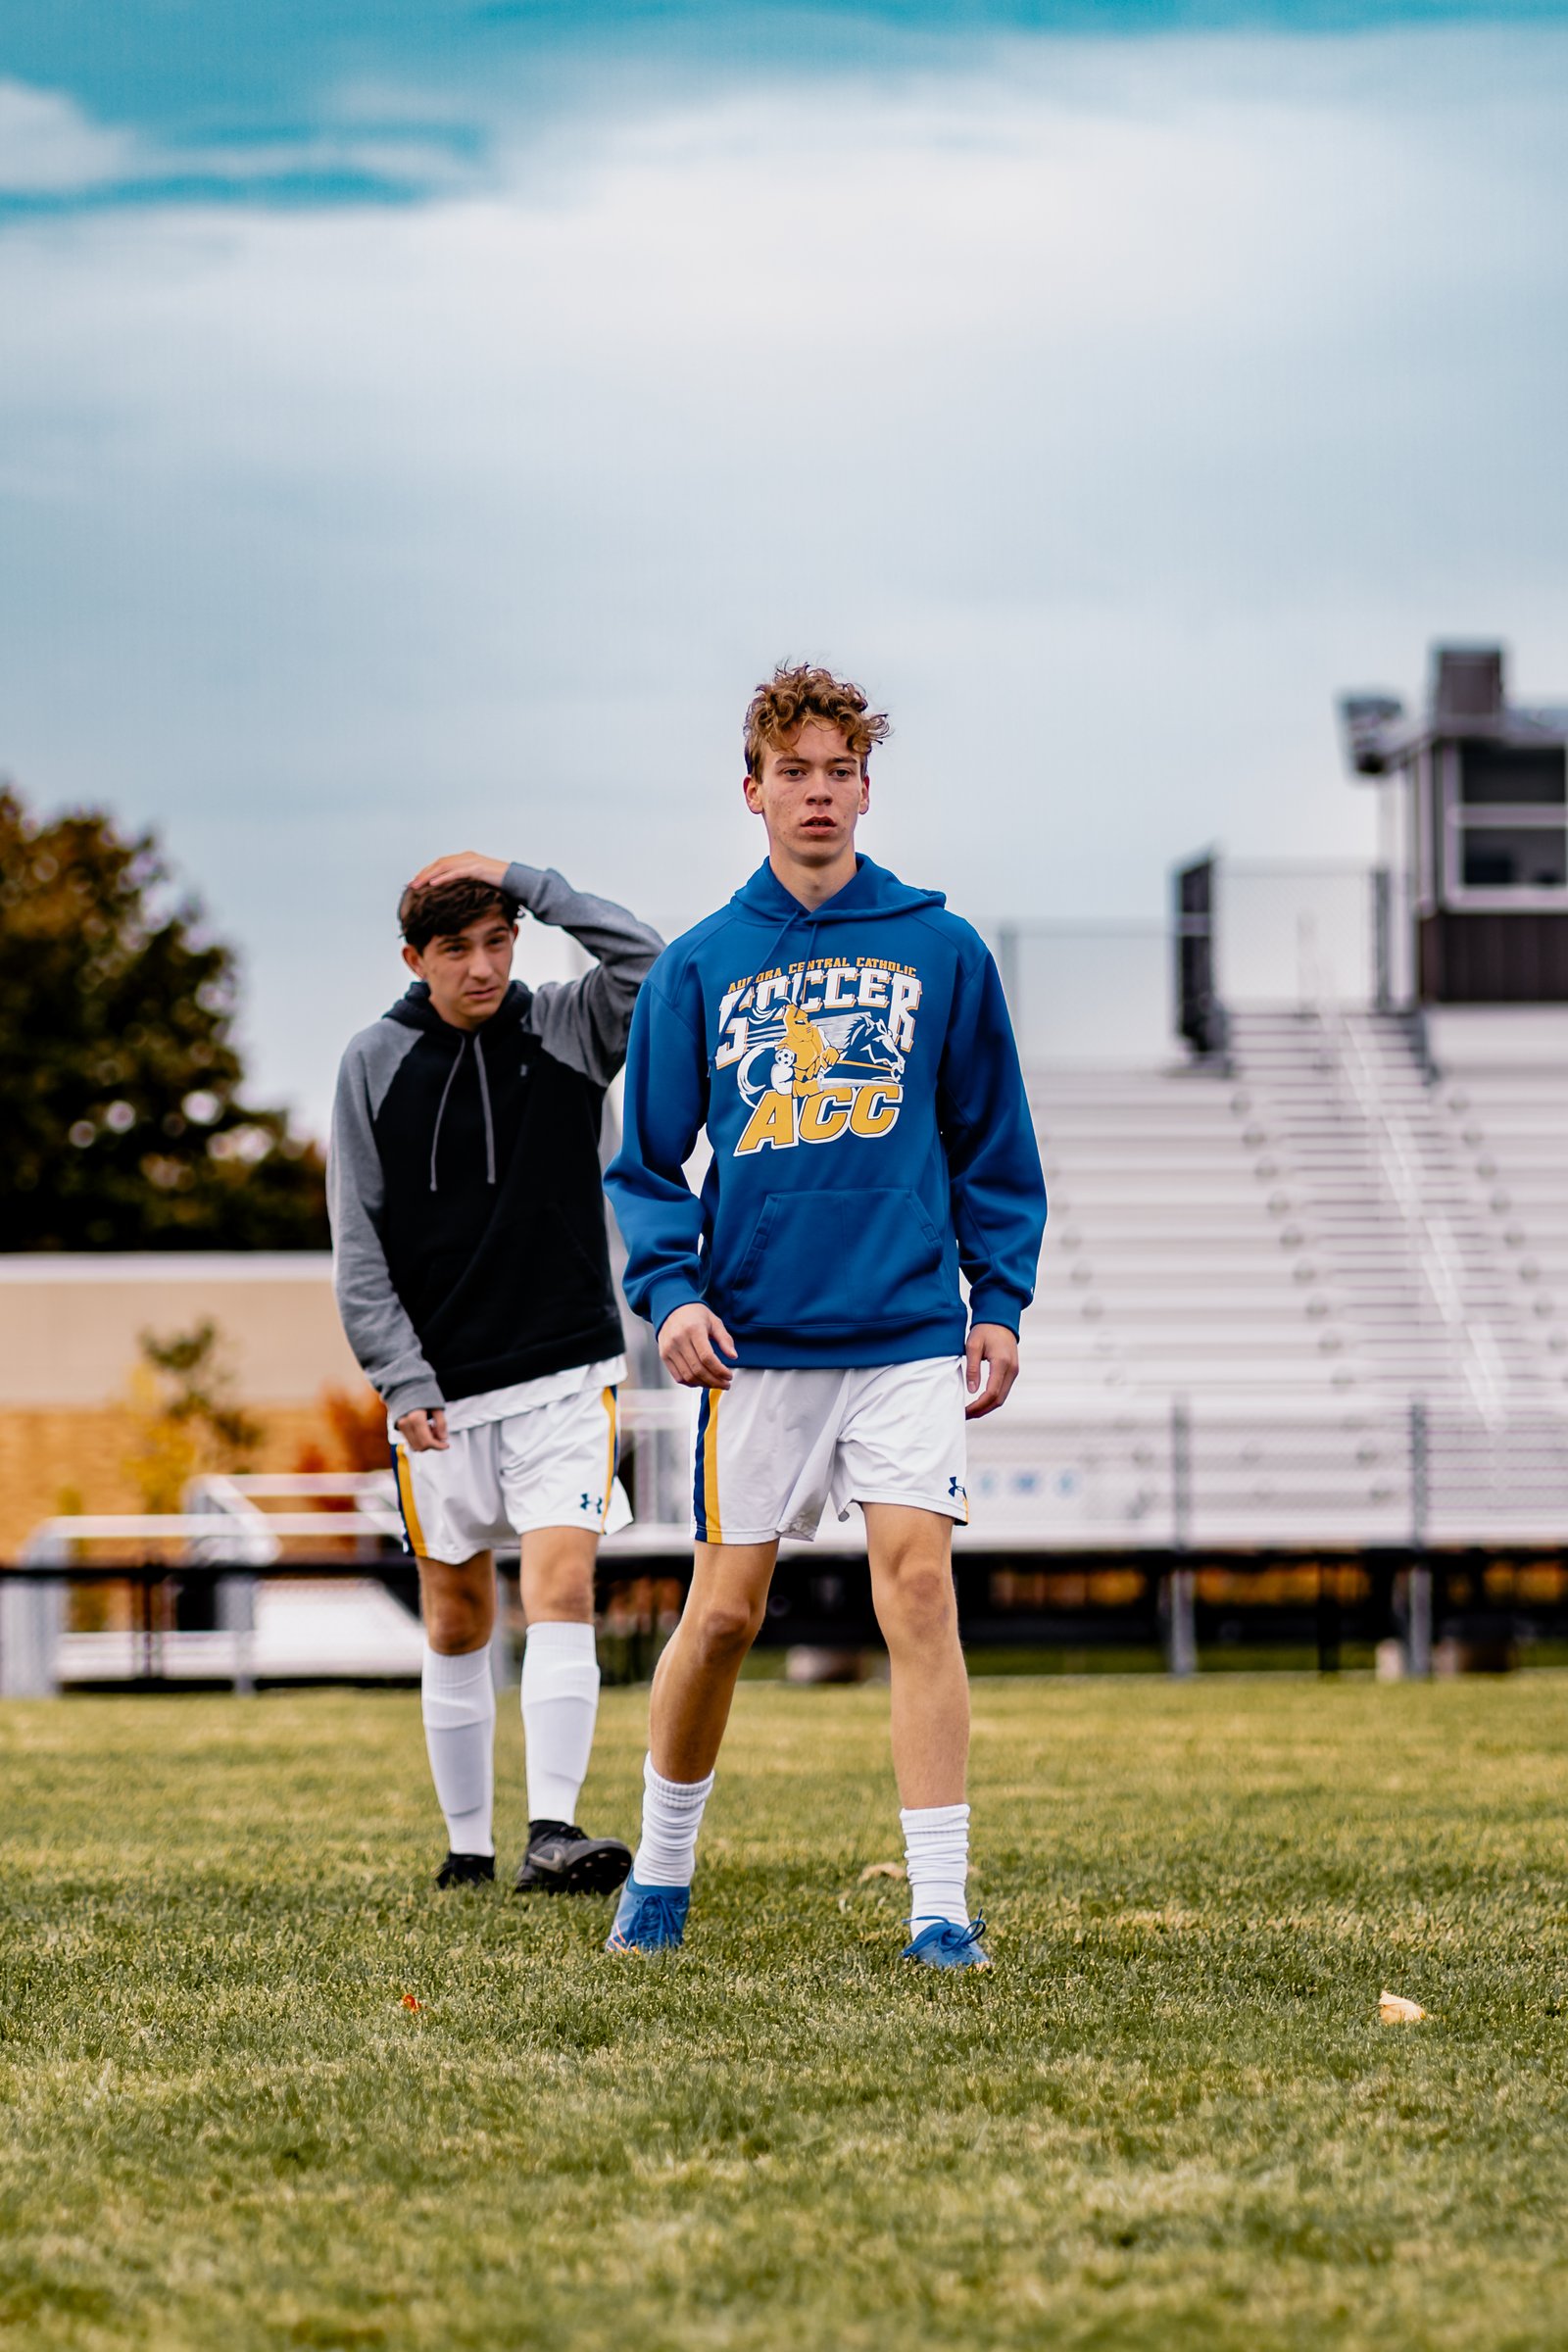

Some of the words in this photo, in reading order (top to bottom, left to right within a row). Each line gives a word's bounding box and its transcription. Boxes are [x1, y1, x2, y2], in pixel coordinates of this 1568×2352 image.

[789, 957, 850, 974] CENTRAL
[856, 956, 916, 977] CATHOLIC
[715, 967, 922, 1070] SOCCER
[733, 1085, 905, 1156] ACC
